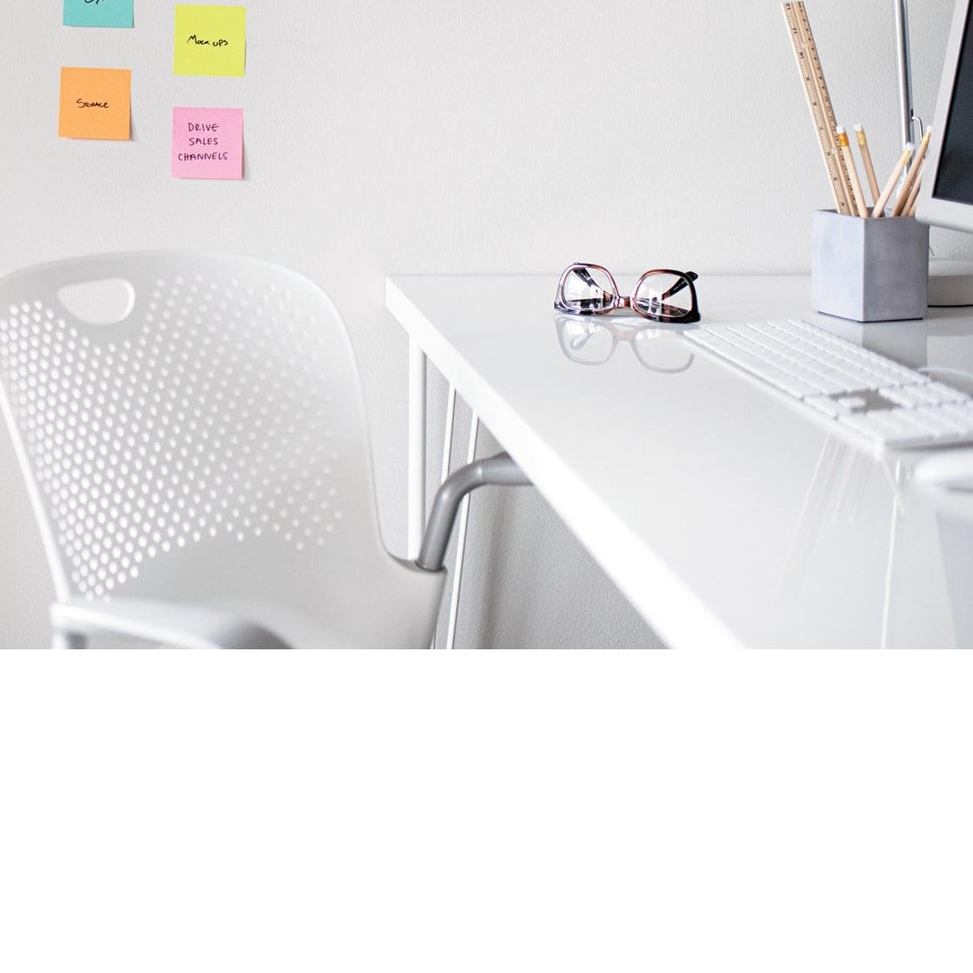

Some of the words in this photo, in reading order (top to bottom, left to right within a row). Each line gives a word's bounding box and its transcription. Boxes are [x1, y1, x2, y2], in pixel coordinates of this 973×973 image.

[187, 122, 220, 133] DRIVE
[188, 137, 219, 147] SALES
[177, 151, 228, 162] CHANNELS
